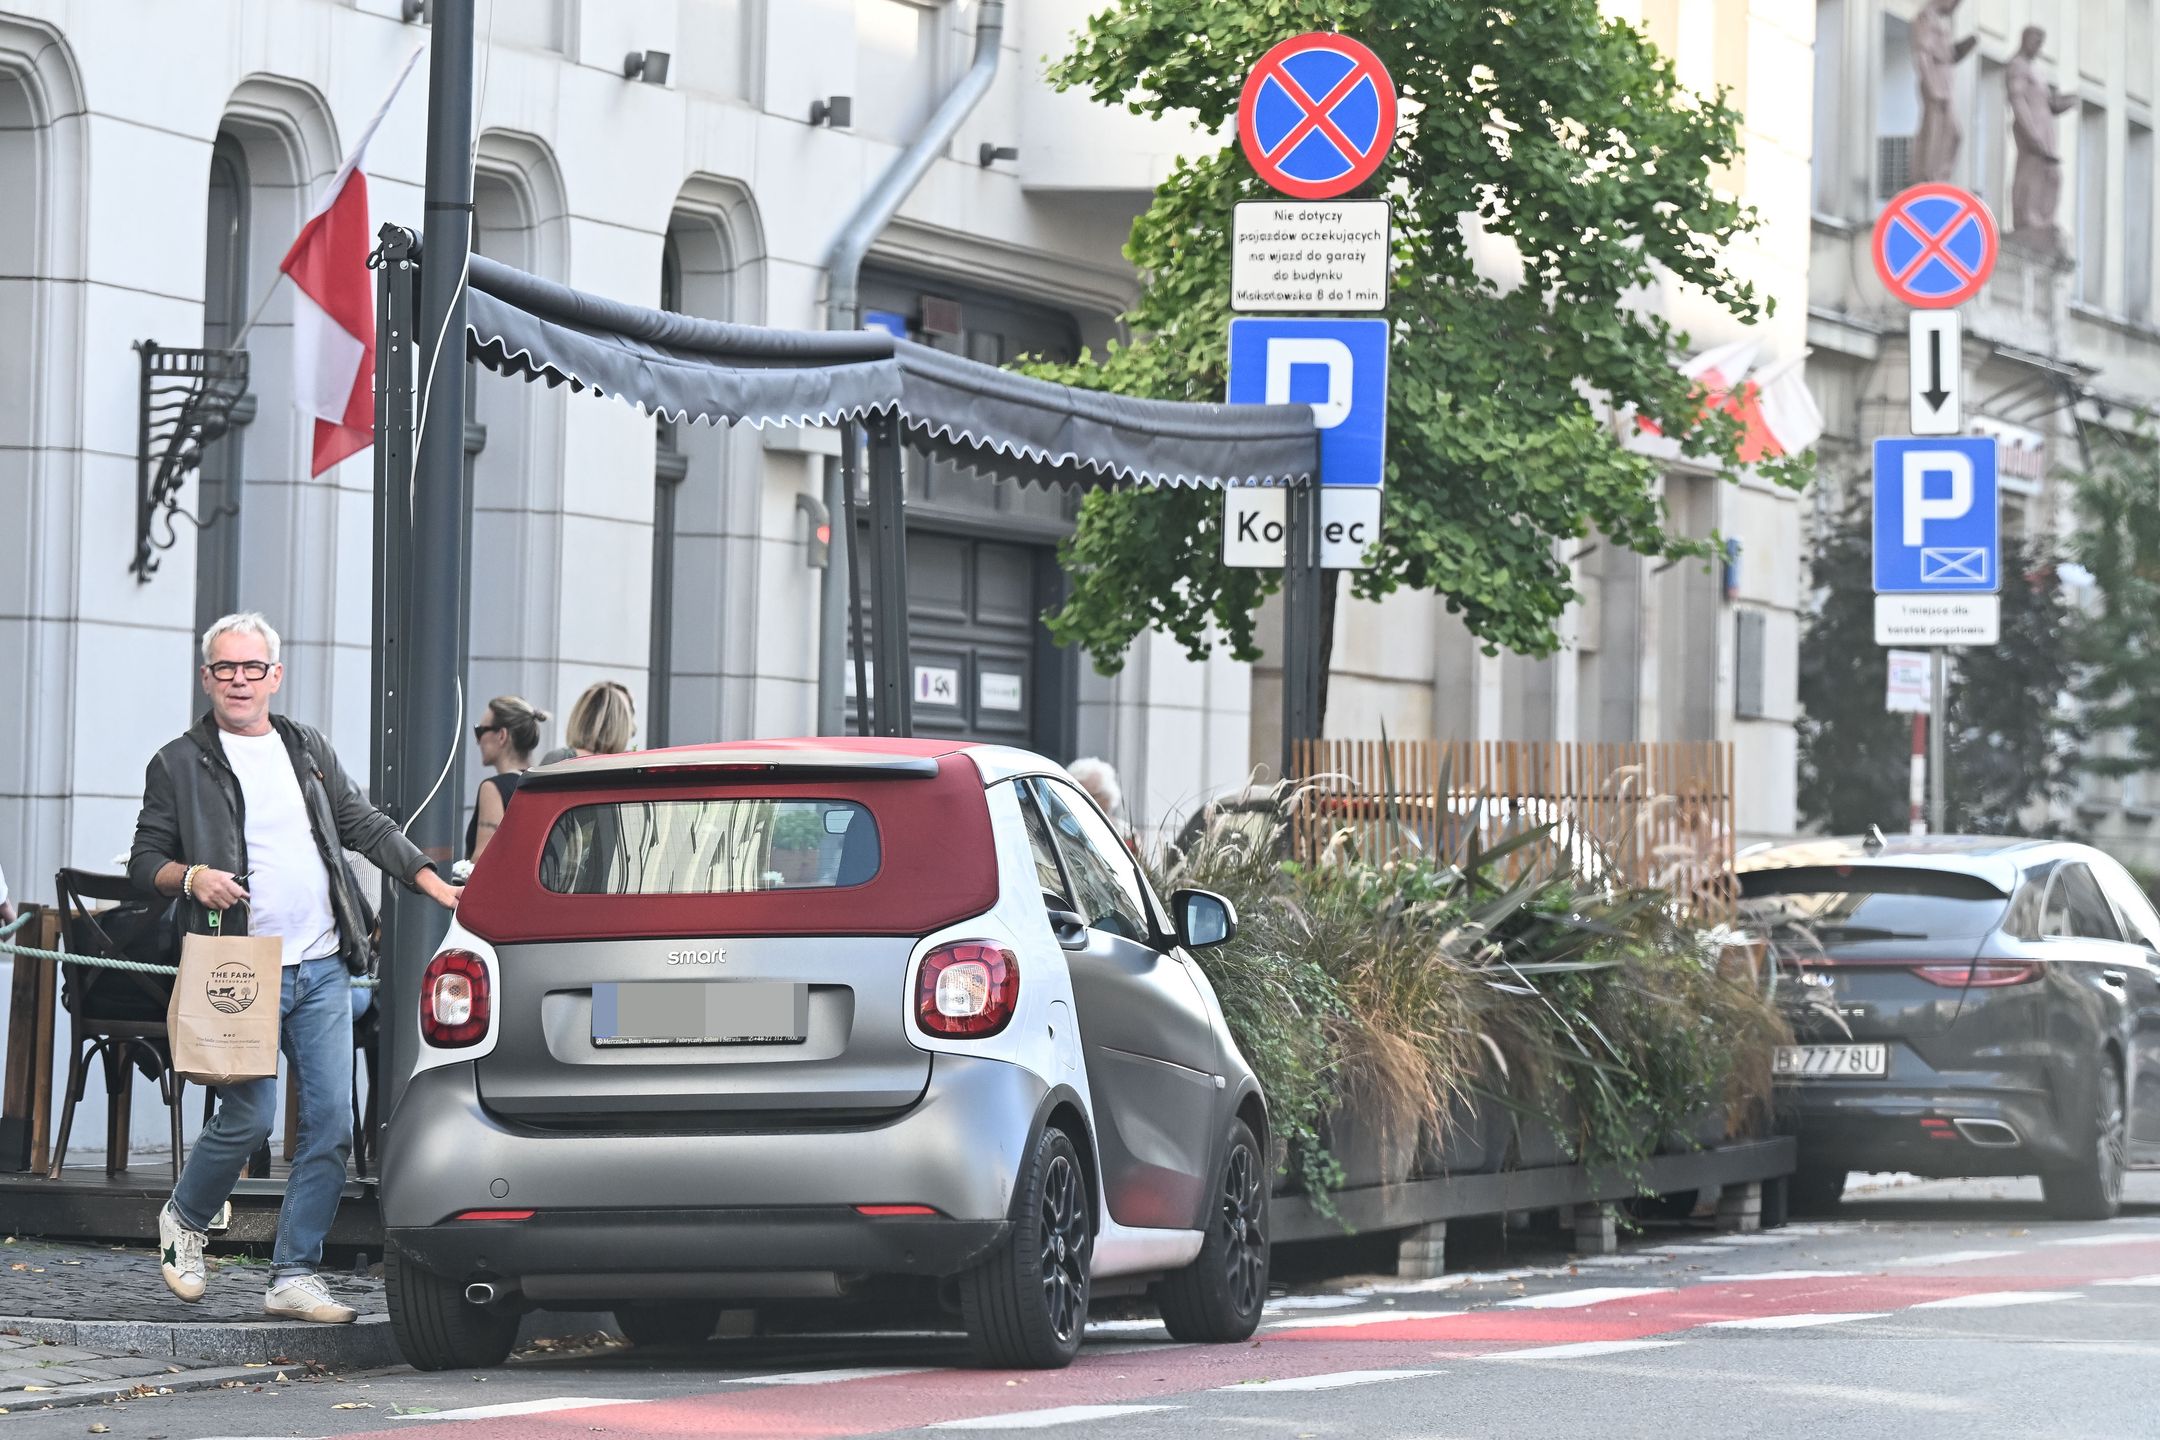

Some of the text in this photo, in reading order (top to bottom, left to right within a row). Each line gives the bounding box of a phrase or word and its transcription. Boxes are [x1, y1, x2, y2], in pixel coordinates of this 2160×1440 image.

[1274, 210, 1342, 223] Nie dotyczy
[1301, 229, 1381, 243] oczekujących
[1270, 250, 1302, 263] wjazd
[1307, 250, 1322, 261] do
[1326, 249, 1366, 263] garaży
[1273, 269, 1343, 283] do budynku
[1317, 288, 1324, 300] 8
[1328, 289, 1343, 300] do
[1267, 338, 1353, 429] P
[1902, 450, 1974, 547] P
[1238, 510, 1365, 544] Koec
[667, 948, 726, 965] smart
